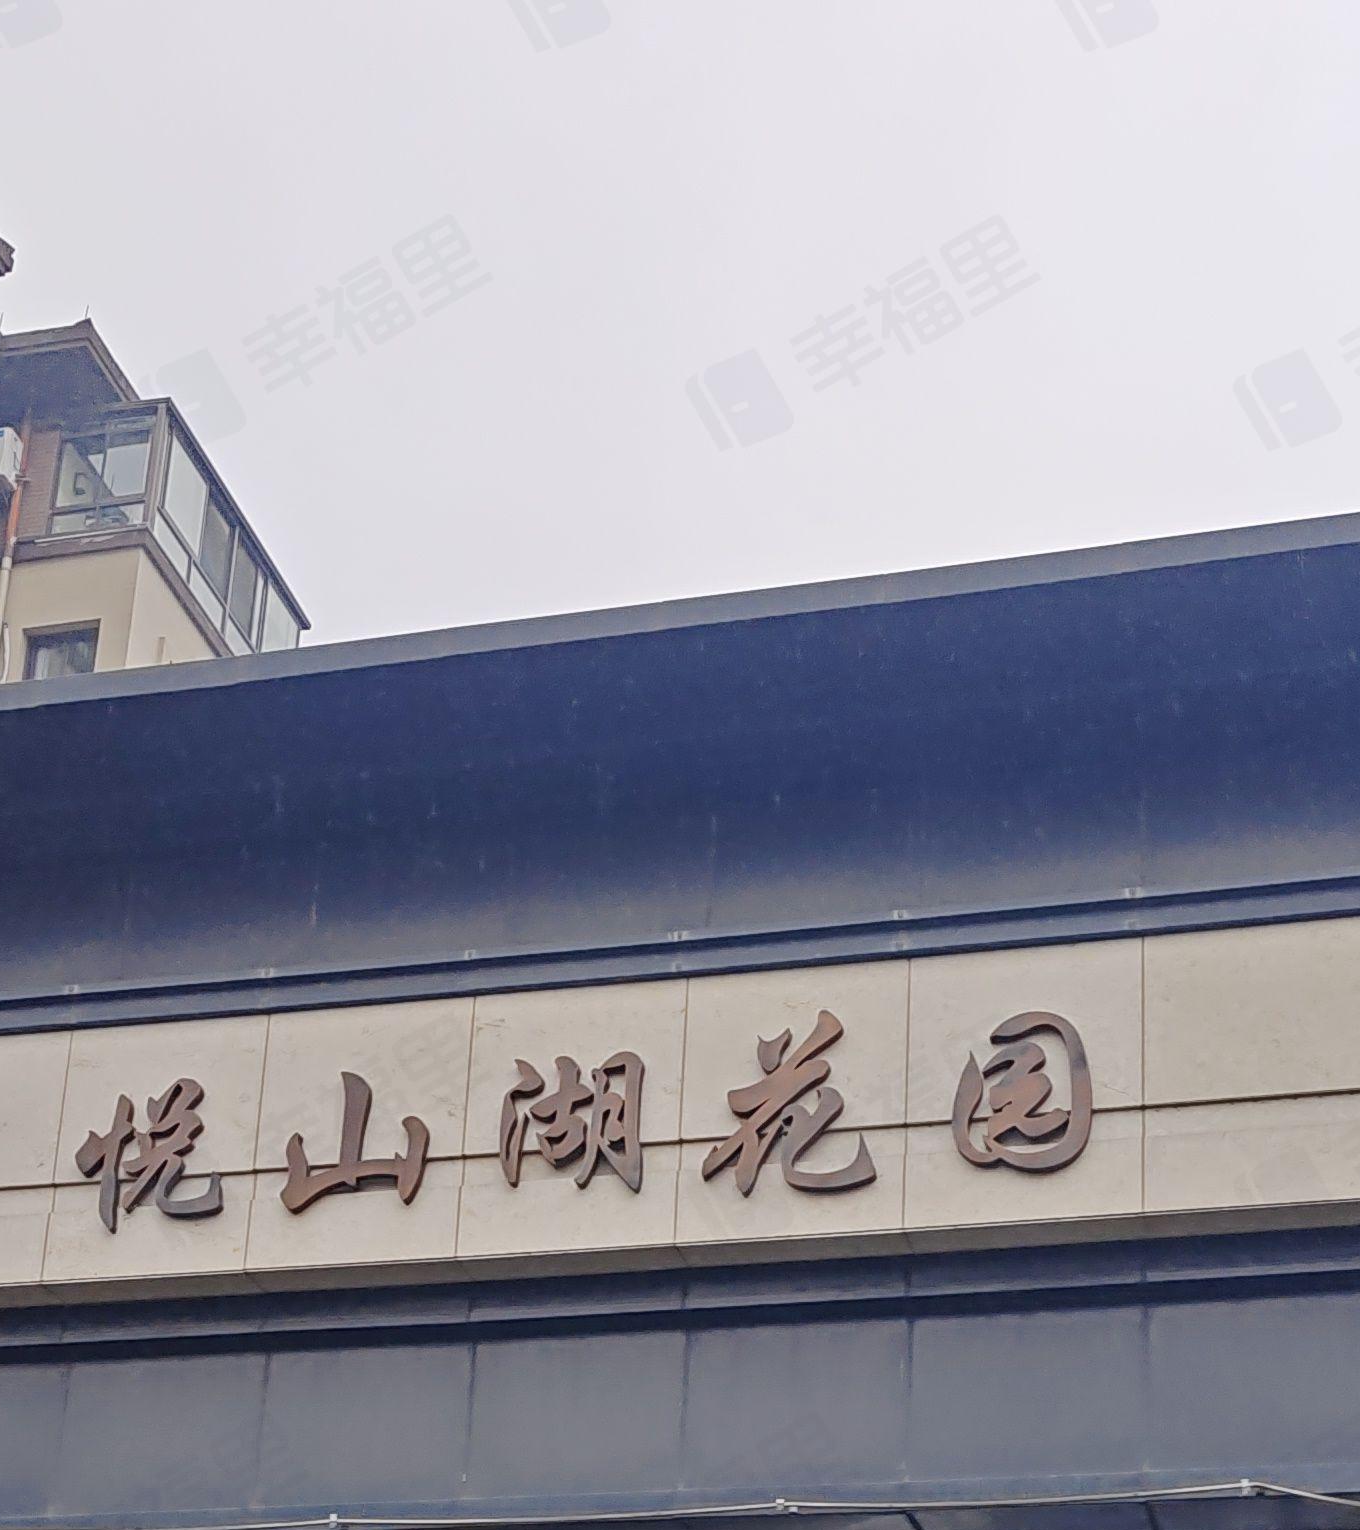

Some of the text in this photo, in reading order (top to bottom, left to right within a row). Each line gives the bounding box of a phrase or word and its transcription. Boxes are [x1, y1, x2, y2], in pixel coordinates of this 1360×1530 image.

[74, 1010, 1092, 1233] 悦山湖花园
